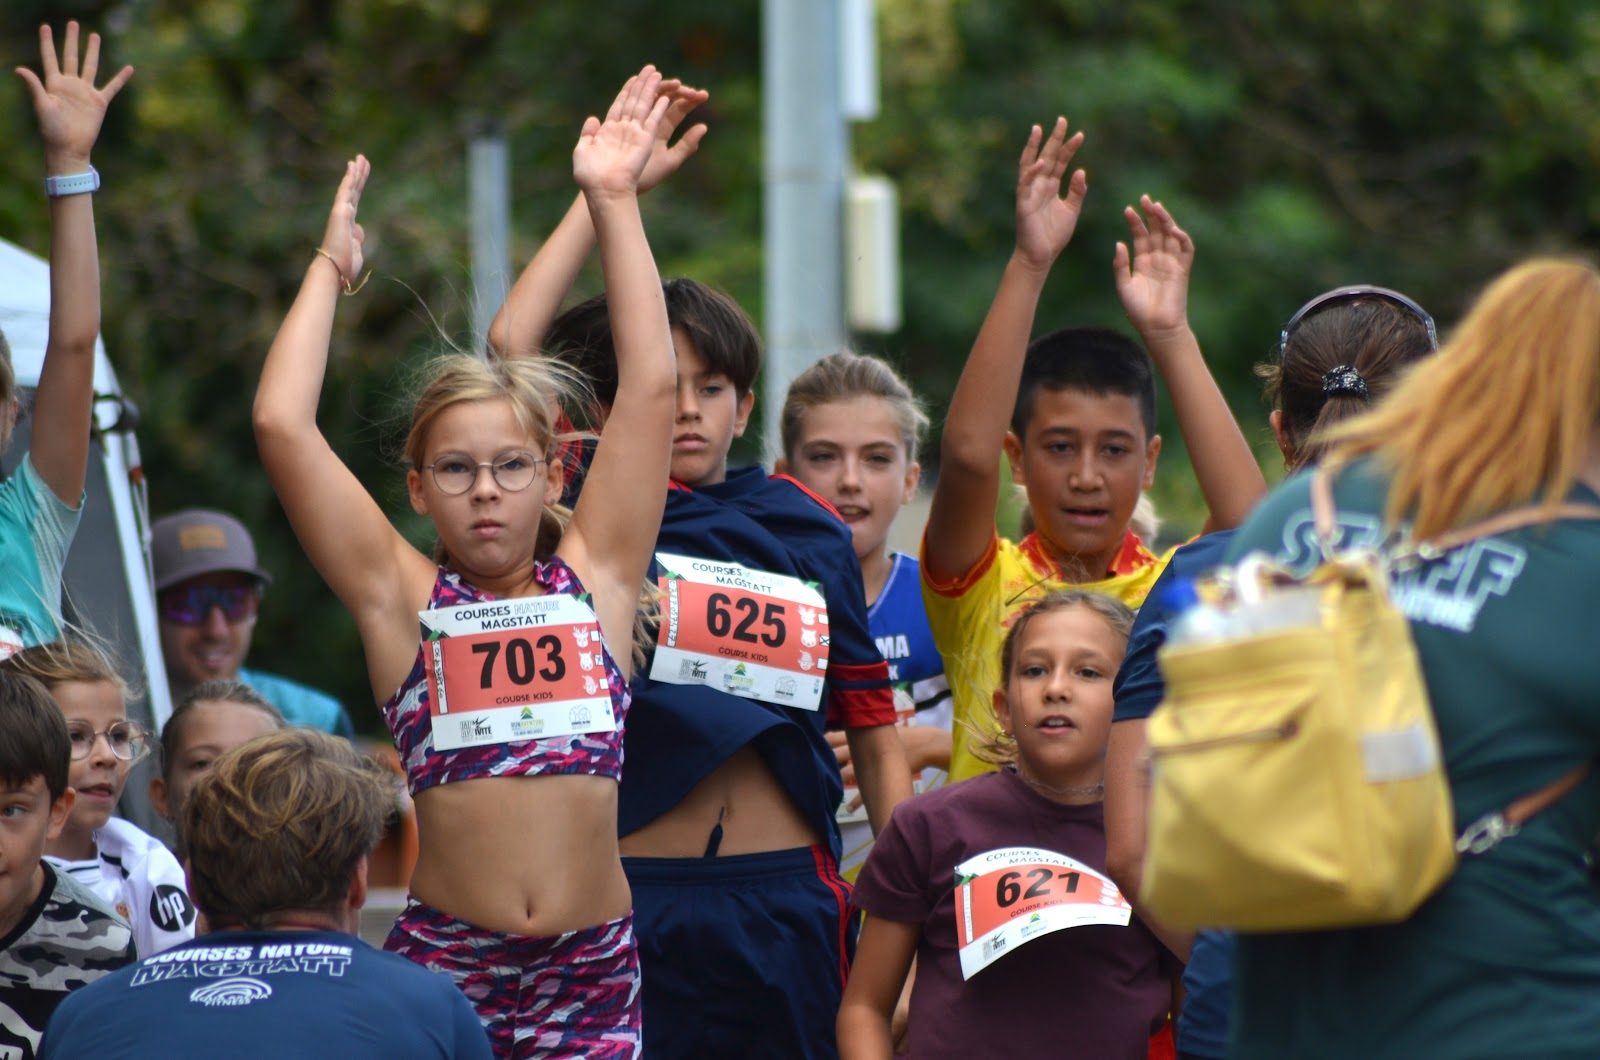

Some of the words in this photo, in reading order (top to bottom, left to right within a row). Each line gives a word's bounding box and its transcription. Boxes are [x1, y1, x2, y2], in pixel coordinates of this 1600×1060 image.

[1283, 509, 1527, 608] STFF
[692, 562, 743, 577] COURSES
[716, 575, 772, 594] MAGSTATT
[455, 606, 511, 622] COURSES
[481, 614, 547, 630] MAGSTATT
[706, 592, 787, 648] 625
[472, 634, 566, 690] 703
[718, 646, 749, 661] COURSE
[751, 653, 769, 663] KIDS
[496, 694, 531, 705] COURSE
[533, 691, 553, 700] KIDS
[986, 850, 1040, 862] COURSES
[996, 868, 1081, 908] 621
[154, 887, 185, 929] hp
[1010, 902, 1041, 918] COURSE
